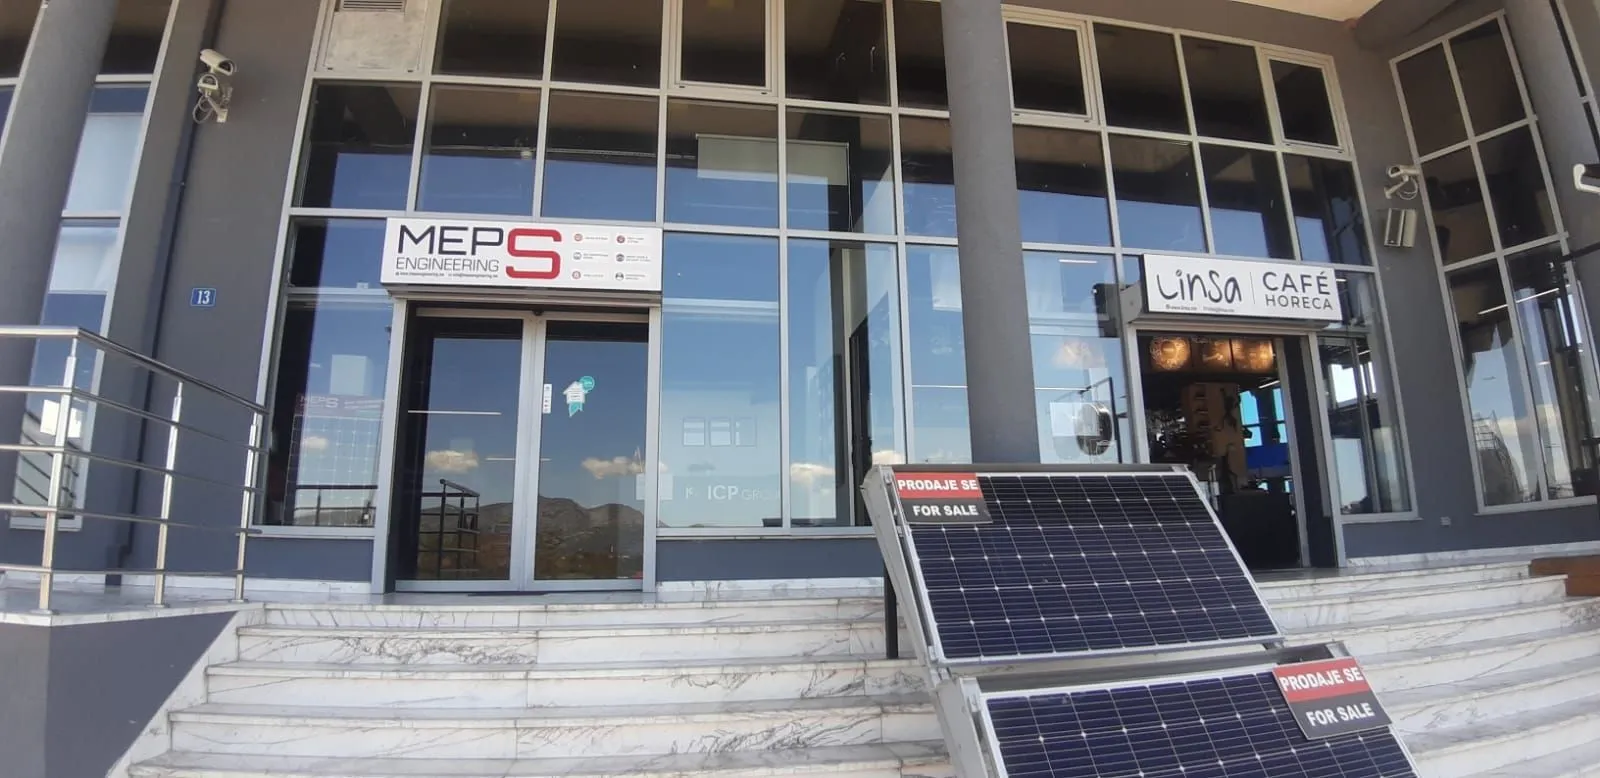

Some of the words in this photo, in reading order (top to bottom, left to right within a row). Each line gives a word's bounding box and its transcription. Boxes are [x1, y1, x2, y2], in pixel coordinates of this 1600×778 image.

[398, 225, 562, 279] MEPS
[396, 257, 499, 272] ENGINEERING
[1262, 271, 1331, 295] CAFÉ
[197, 290, 211, 304] 13
[1265, 293, 1333, 311] HORECA
[707, 484, 739, 501] ICP
[897, 479, 958, 491] PRODAJE
[961, 479, 979, 490] SE
[912, 505, 942, 516] FOR
[944, 505, 979, 516] SALE
[1279, 670, 1345, 692] PRODAJE
[1343, 666, 1364, 682] SE
[1306, 708, 1339, 727] FOR
[1337, 702, 1375, 722] SALE
